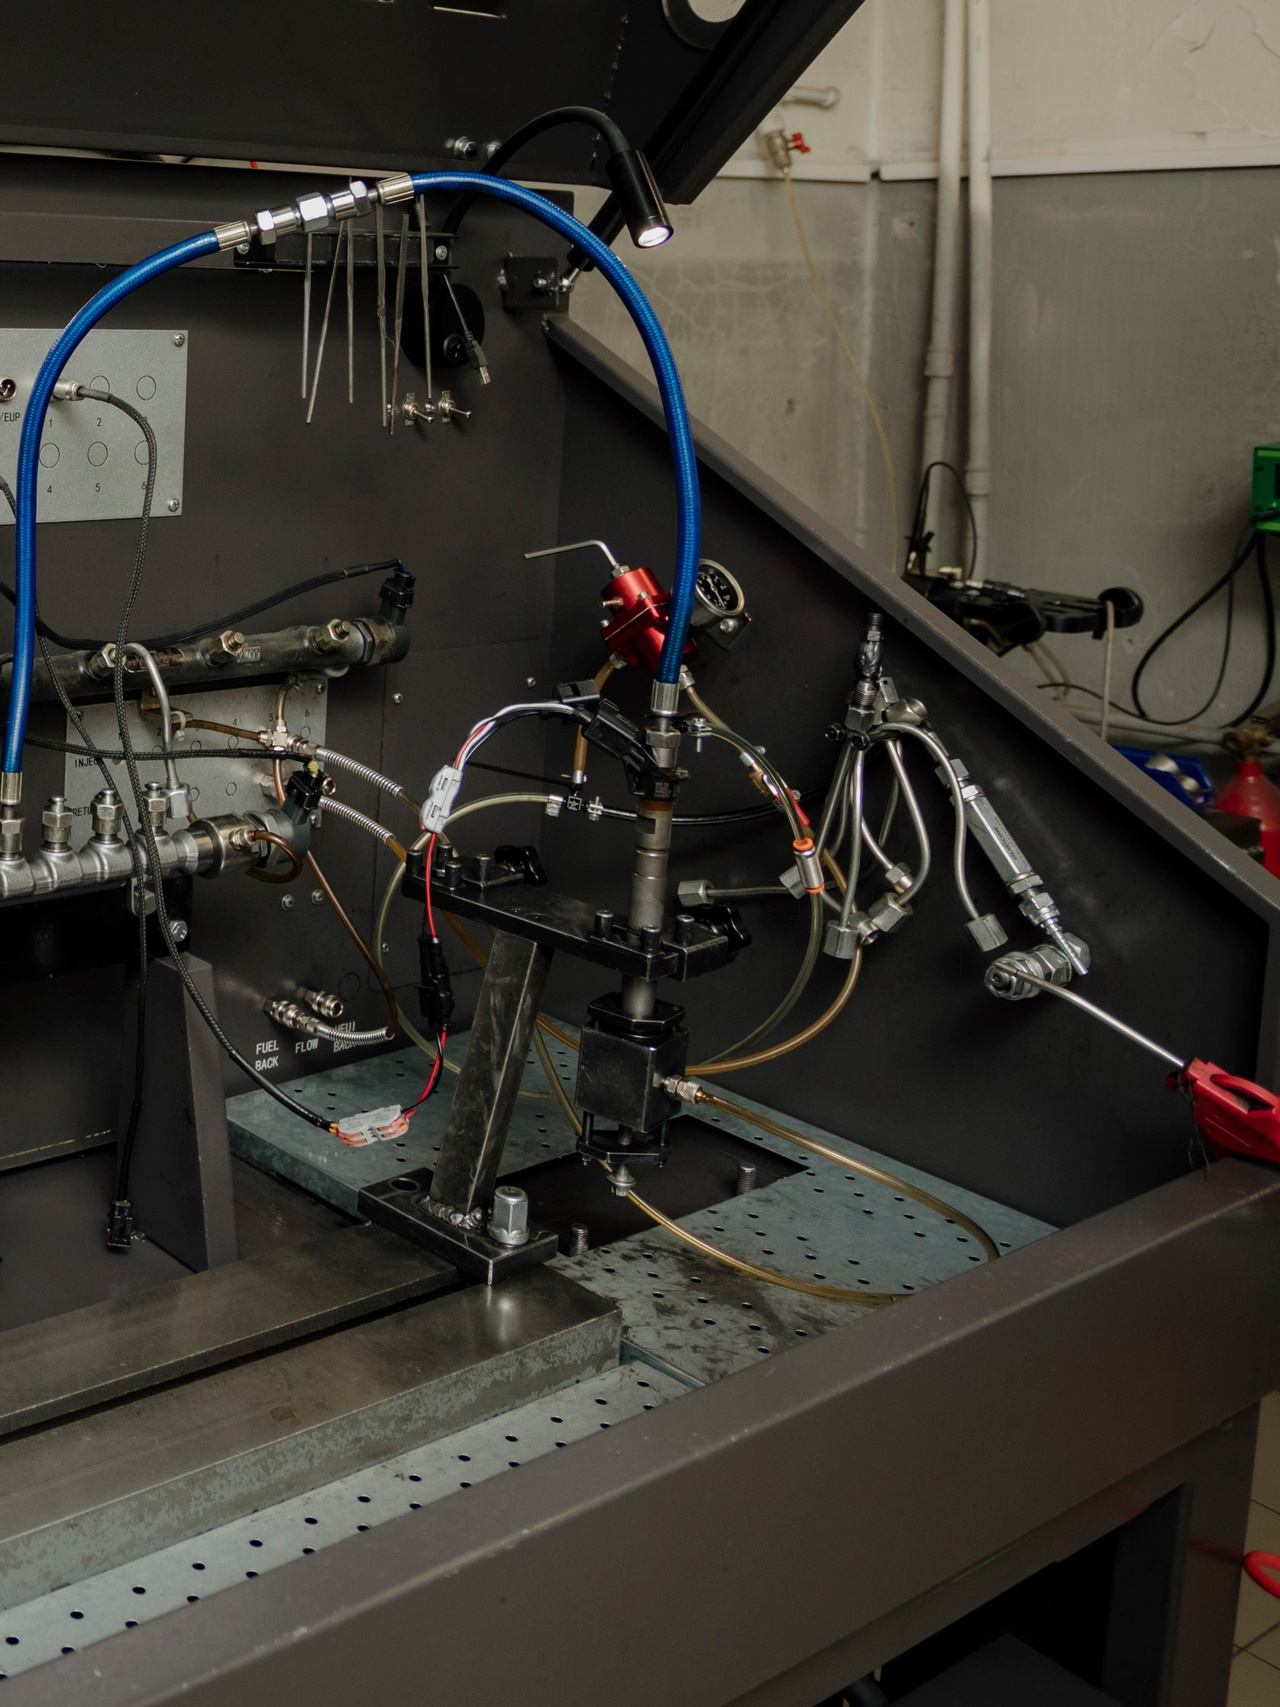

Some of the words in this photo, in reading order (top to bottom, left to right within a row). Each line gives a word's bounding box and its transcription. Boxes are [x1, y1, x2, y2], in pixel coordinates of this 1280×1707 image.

[96, 418, 102, 427] 2
[47, 485, 53, 494] 4
[95, 484, 101, 492] 5
[256, 1040, 279, 1055] FUEL
[295, 1038, 319, 1054] FLOW
[255, 1056, 279, 1072] BACK
